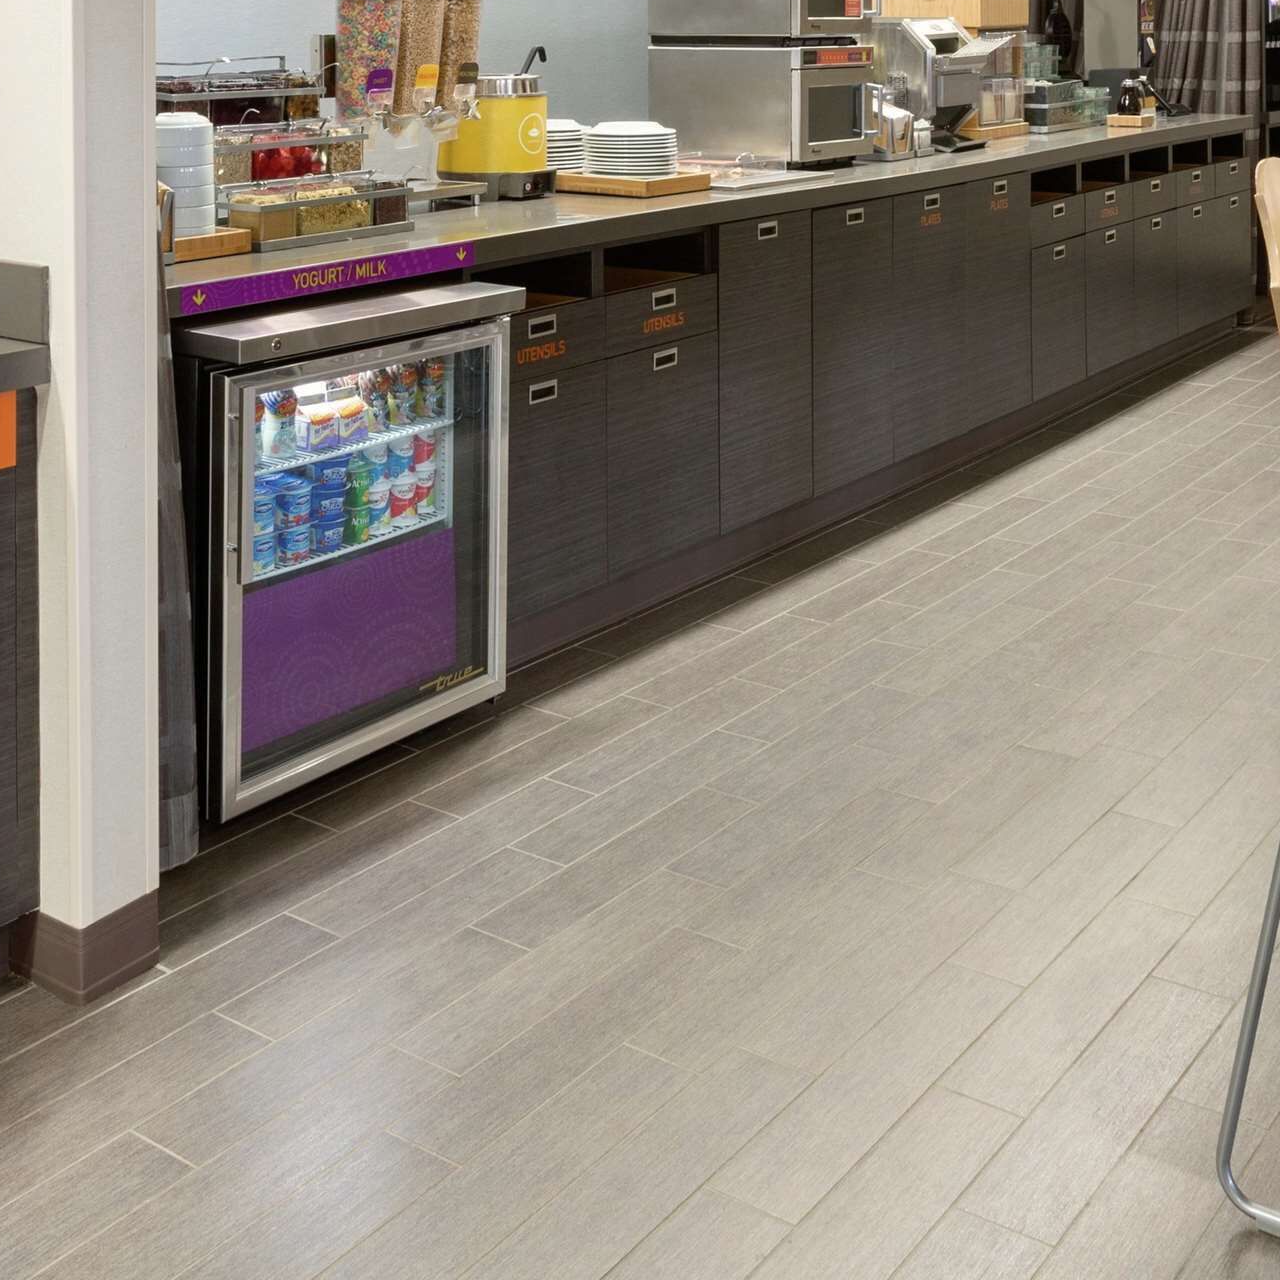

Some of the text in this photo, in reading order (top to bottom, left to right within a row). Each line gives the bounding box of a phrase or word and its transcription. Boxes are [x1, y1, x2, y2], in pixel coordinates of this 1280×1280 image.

[292, 266, 345, 289] YOGURT
[355, 259, 387, 279] MILK
[642, 311, 686, 335] UTENSILS
[516, 339, 567, 366] UTENSILS
